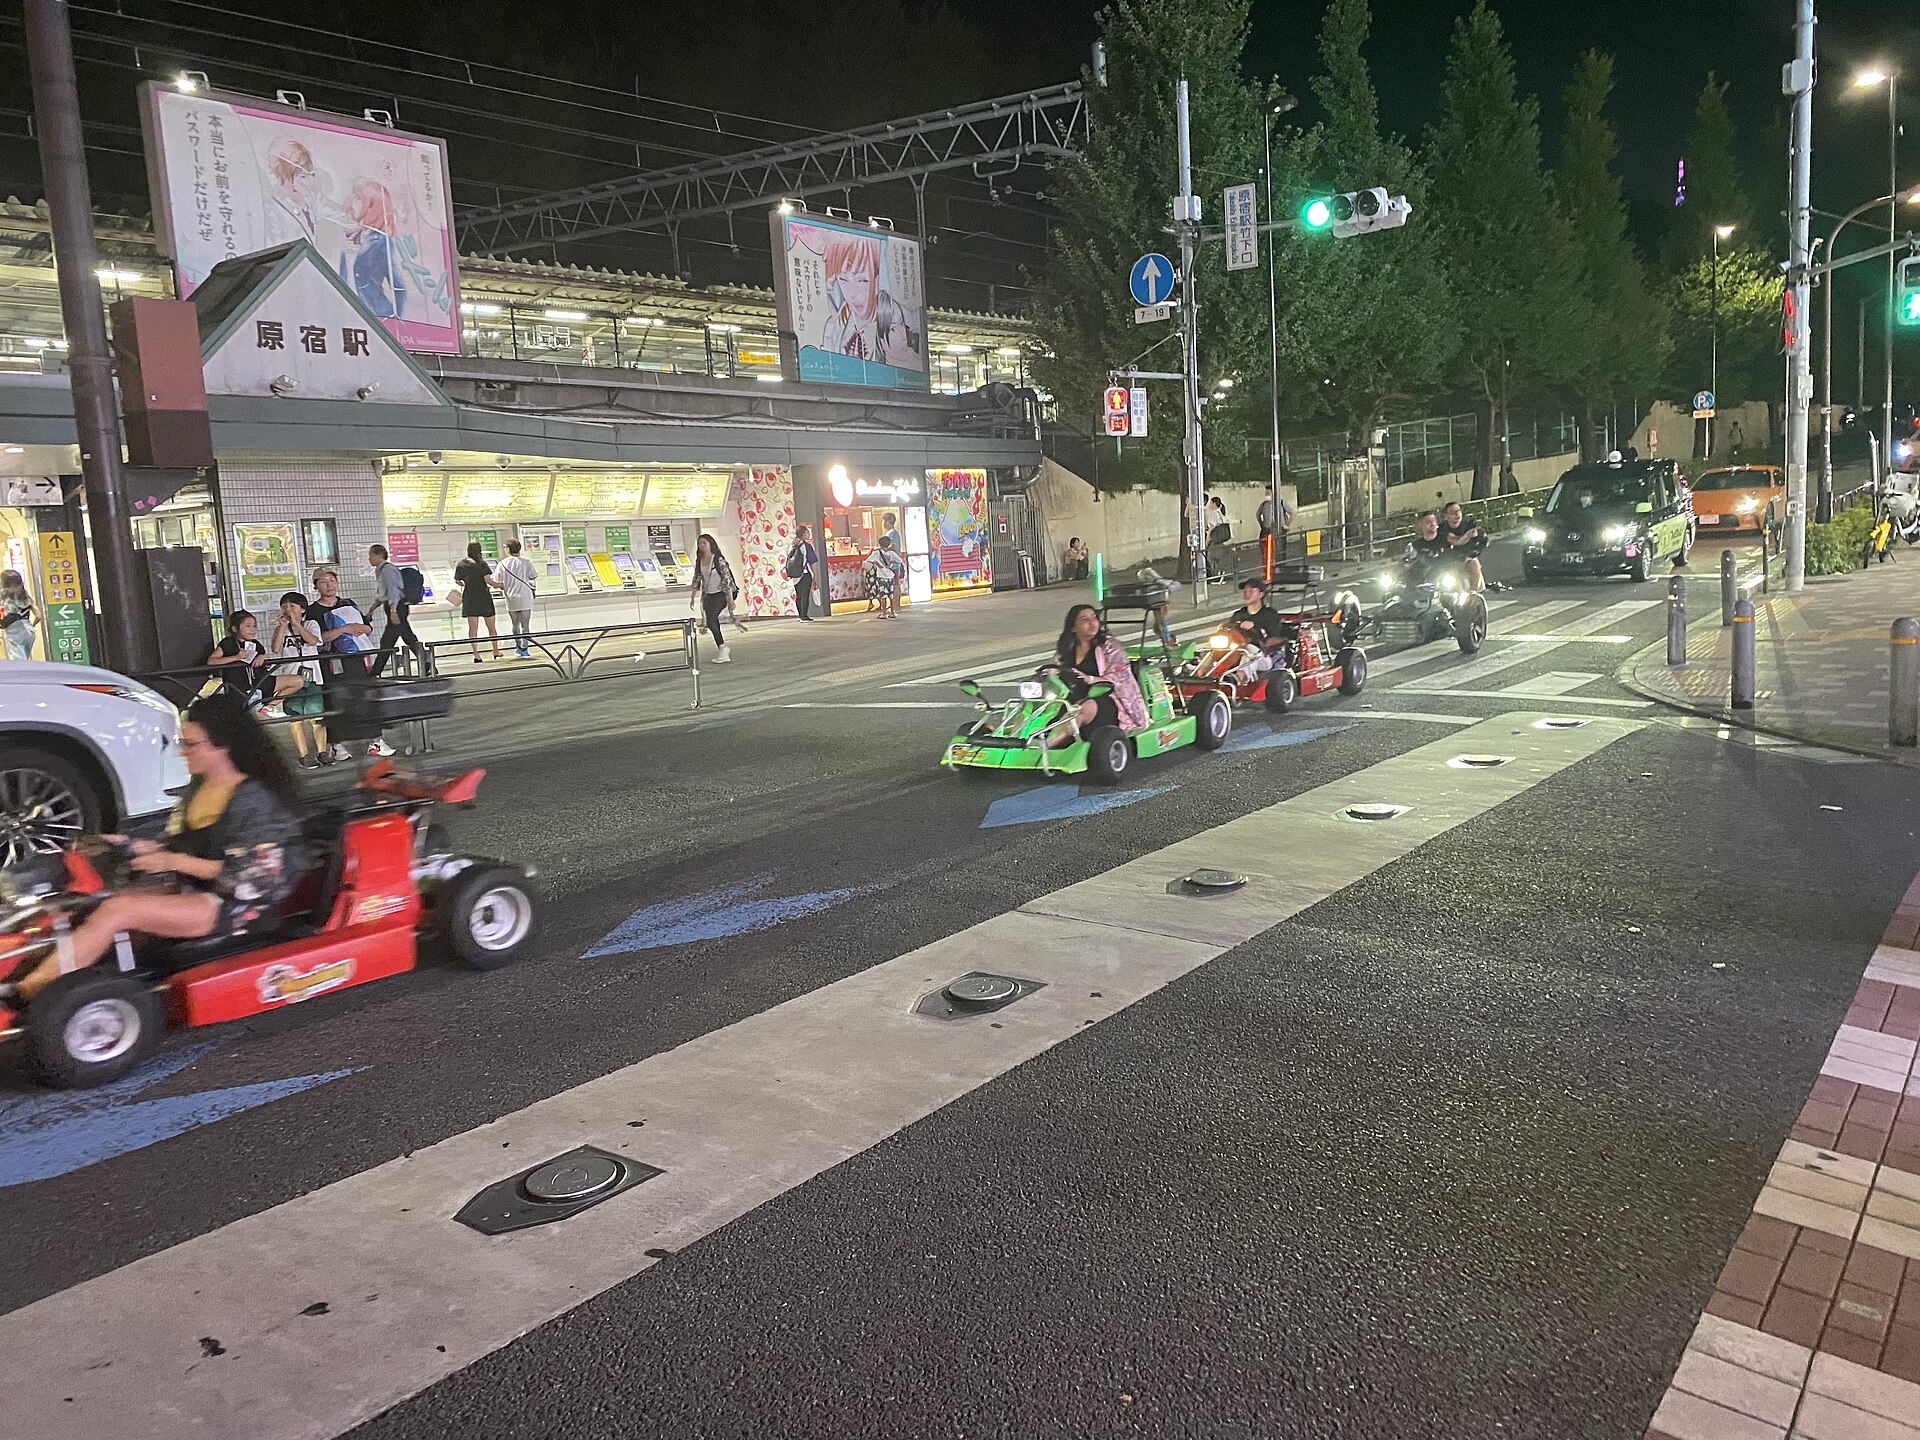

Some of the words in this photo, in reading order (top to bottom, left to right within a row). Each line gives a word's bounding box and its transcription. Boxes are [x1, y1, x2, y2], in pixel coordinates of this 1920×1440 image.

[185, 111, 214, 242] パスワードだけだぜ
[1239, 189, 1253, 264] 原宿駅竹下口
[256, 320, 371, 357] 原宿駅
